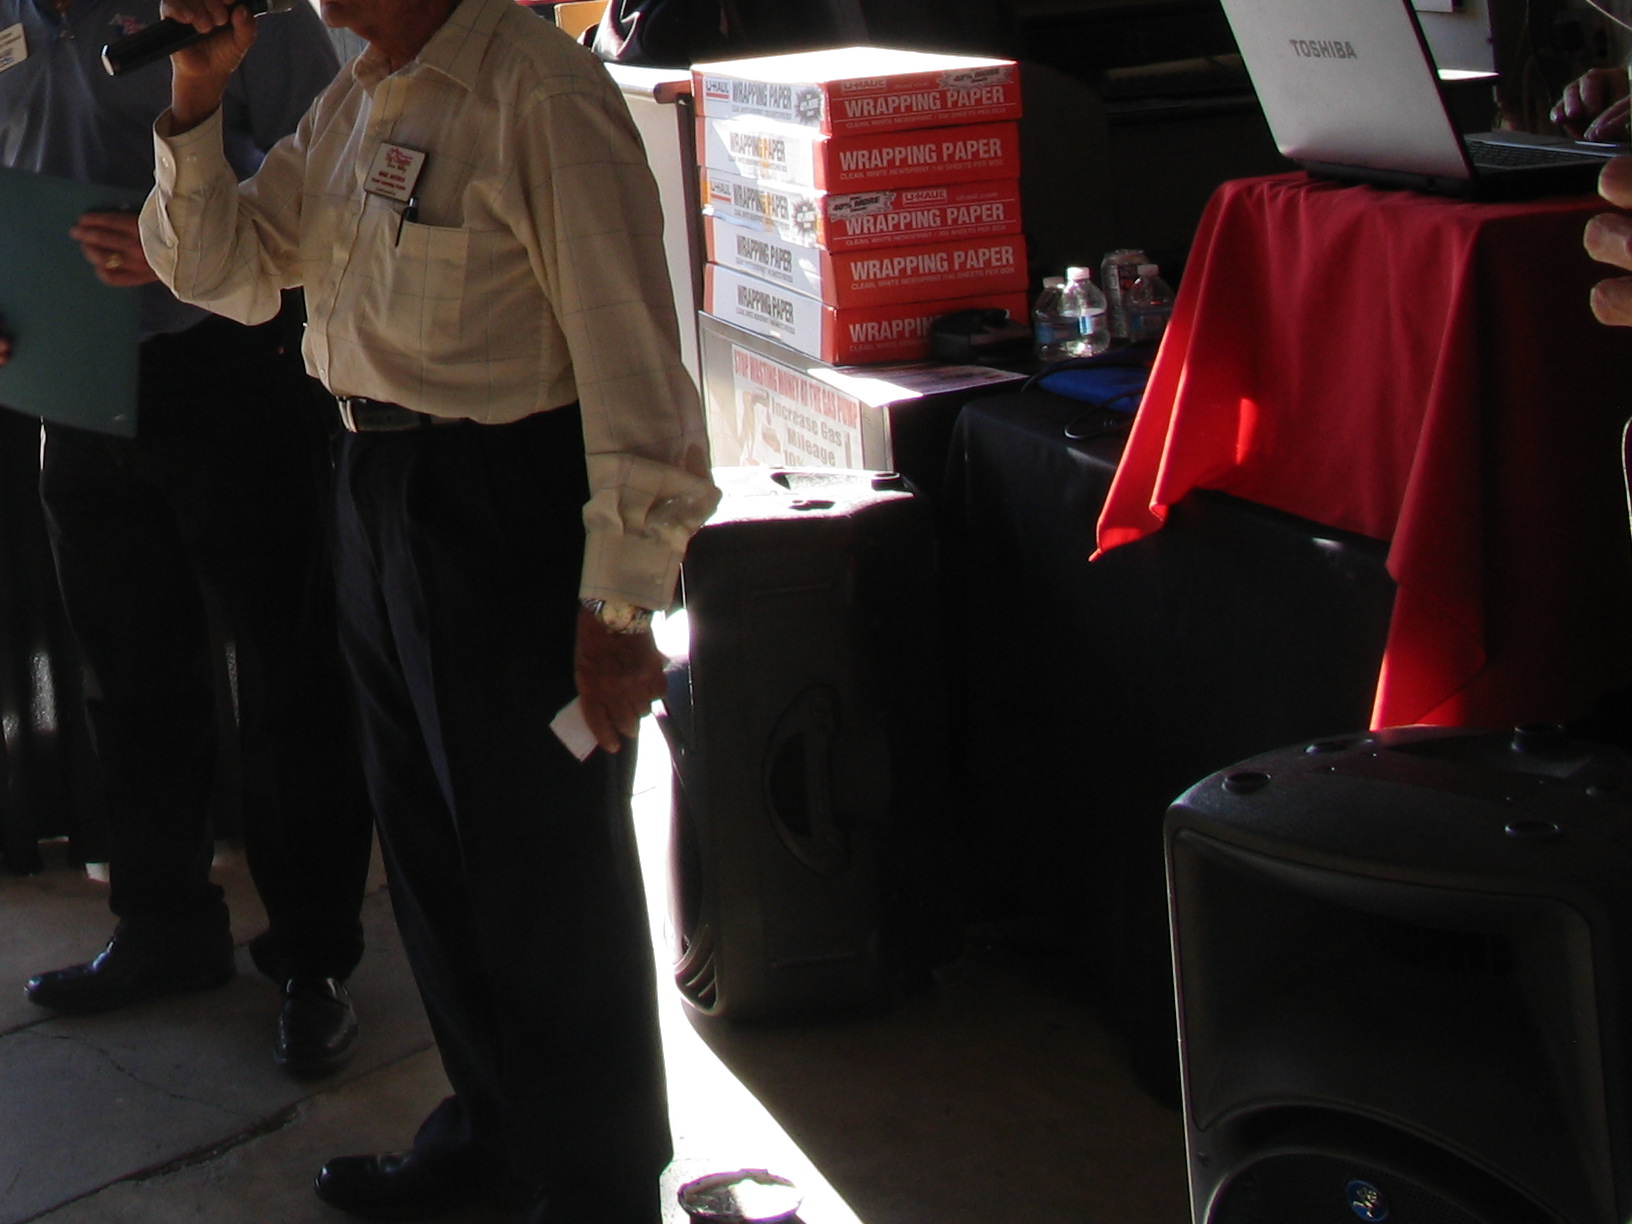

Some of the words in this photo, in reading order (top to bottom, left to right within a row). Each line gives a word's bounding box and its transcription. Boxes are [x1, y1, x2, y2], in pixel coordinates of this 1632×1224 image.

[1289, 38, 1358, 60] TOSHIBA
[732, 80, 767, 107] WRAPPING
[768, 84, 792, 110] PAPER
[844, 92, 941, 119] WRAPPING
[946, 86, 1005, 109] PAPER
[839, 143, 937, 172] WRAPPING
[942, 137, 1002, 161] PAPER
[903, 190, 945, 201] U-HAUL
[846, 209, 941, 236] WRAPPING
[946, 203, 1004, 227] PAPER
[737, 234, 769, 265] WRAPPING
[770, 245, 792, 273] PAPER
[850, 254, 949, 281] WRAPPING
[953, 246, 1015, 271] PAPER
[737, 284, 771, 316] WRAPPING
[772, 296, 793, 324] PAPER
[772, 397, 818, 436] Increase
[821, 421, 842, 447] Gas
[787, 427, 836, 467] Mileage
